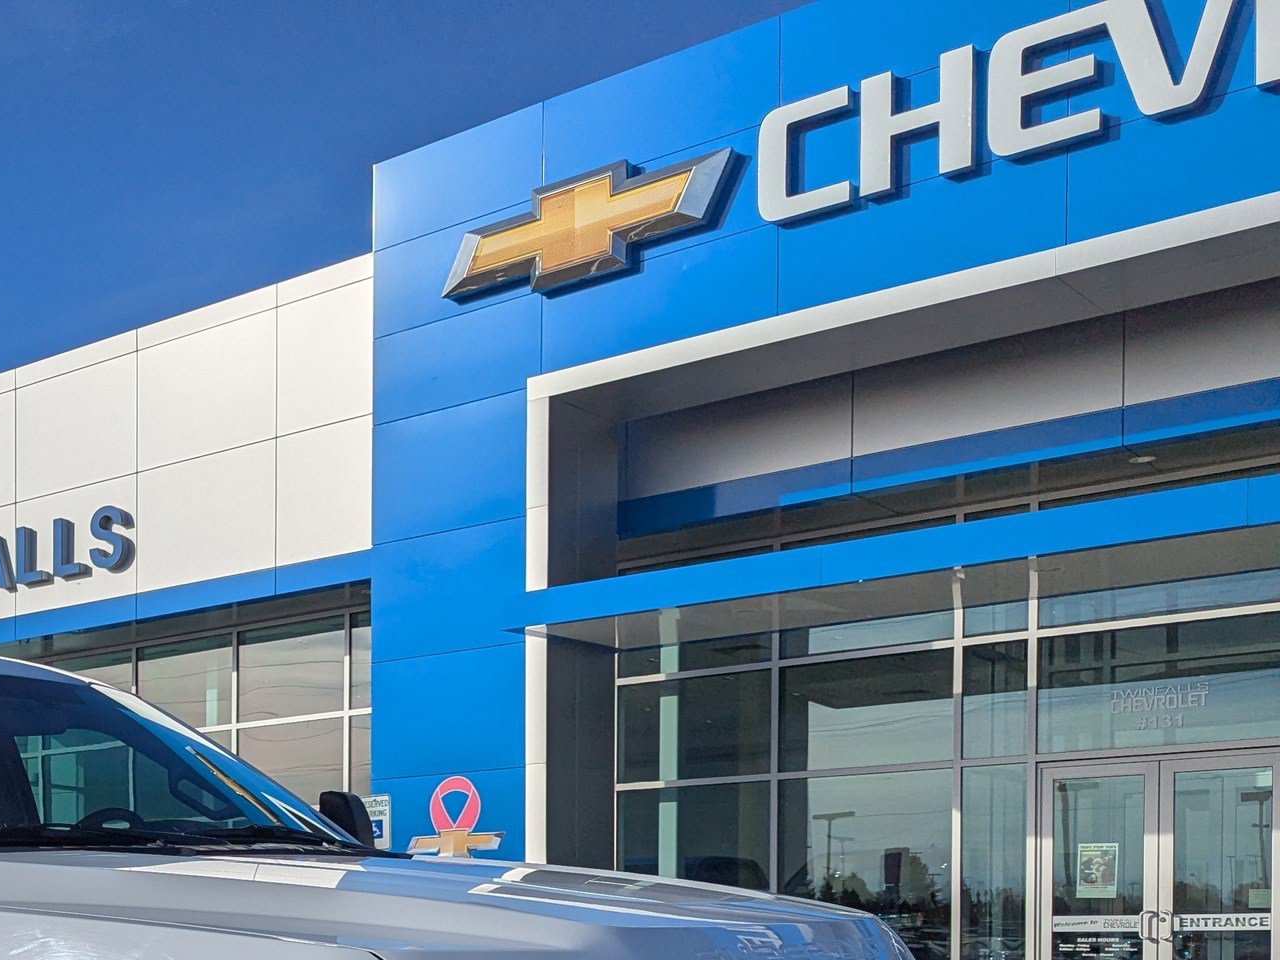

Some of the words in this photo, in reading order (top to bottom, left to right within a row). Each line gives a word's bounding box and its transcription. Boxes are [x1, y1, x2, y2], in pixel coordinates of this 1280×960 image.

[757, 0, 1280, 223] CHEV
[1111, 682, 1209, 699] TWINFALLS
[1111, 691, 1209, 714] CHEVROLET
[1138, 713, 1184, 730] #131
[364, 799, 388, 808] ESERVED
[370, 809, 387, 817] RKING
[1053, 920, 1088, 928] Welcome
[1179, 917, 1269, 928] ENTRANCE
